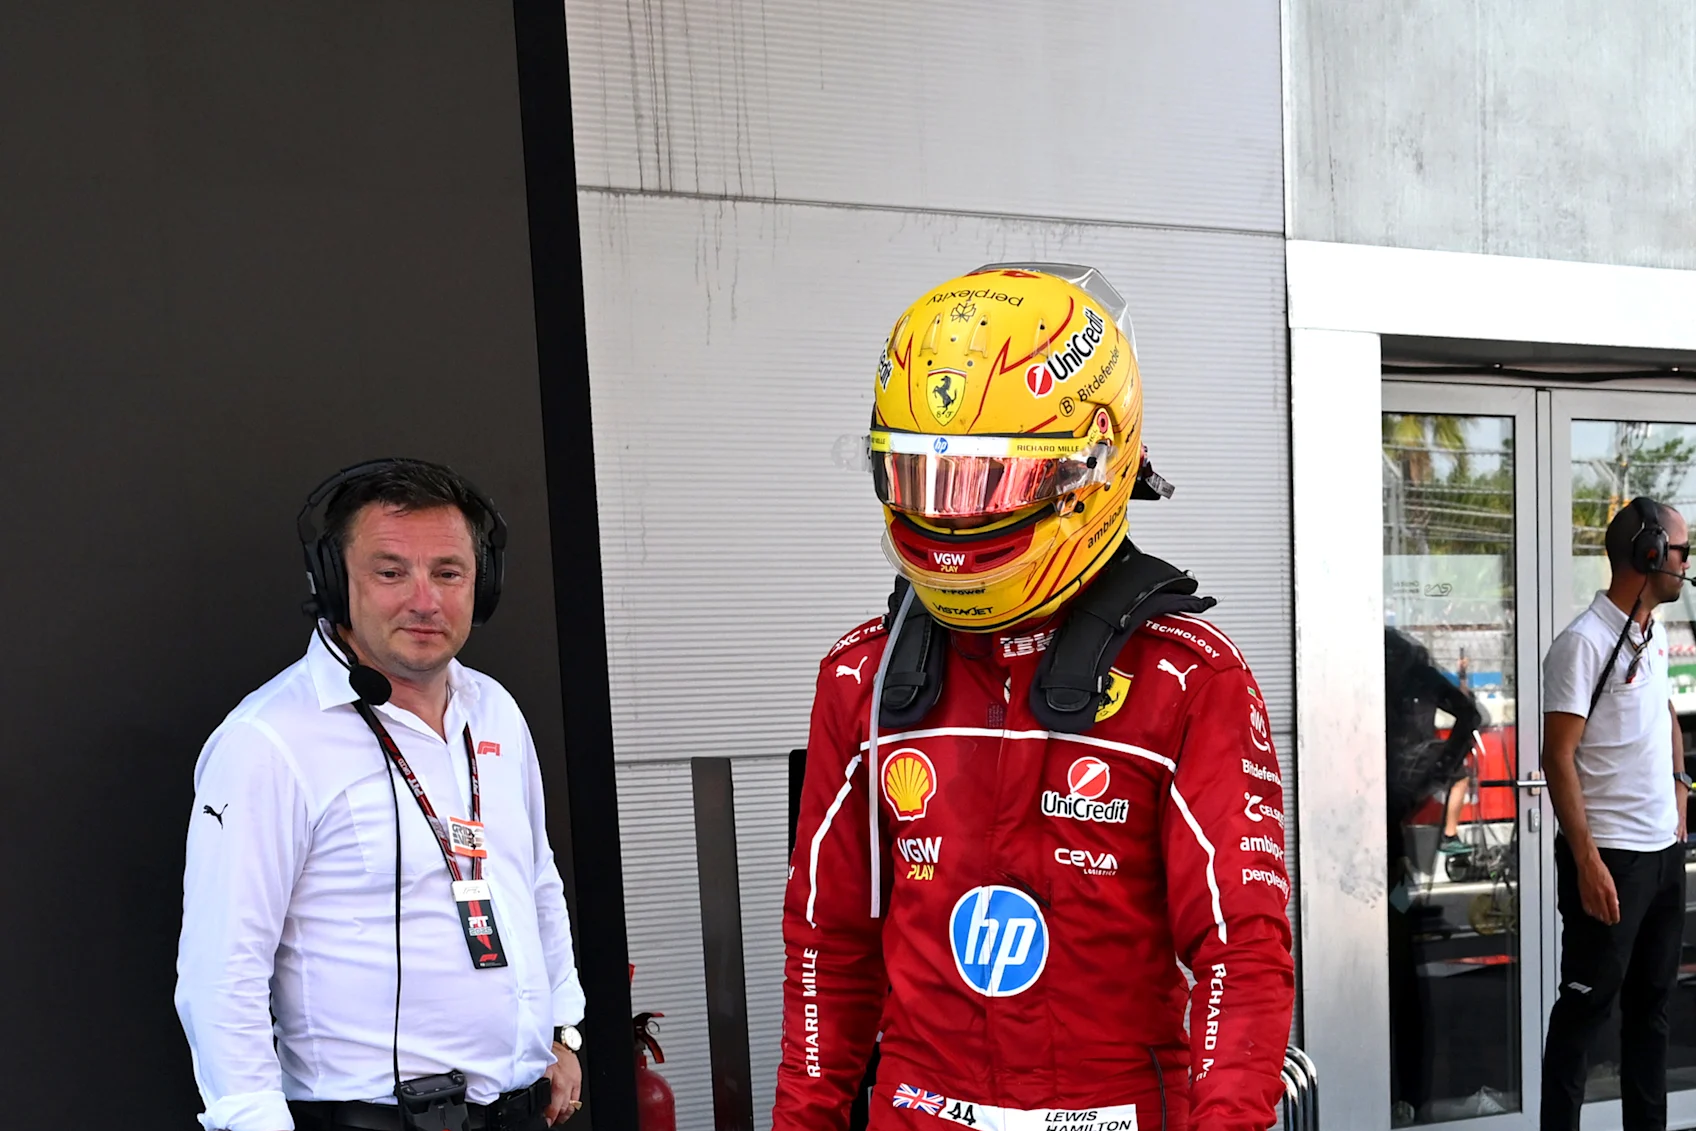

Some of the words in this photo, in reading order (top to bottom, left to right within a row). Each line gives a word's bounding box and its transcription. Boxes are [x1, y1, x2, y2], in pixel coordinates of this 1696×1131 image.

[926, 289, 1024, 307] perplexity
[1050, 309, 1104, 380] UniCredit
[1077, 344, 1120, 402] Bitdefender
[934, 437, 948, 453] hp
[1017, 444, 1055, 452] RICHARD
[933, 552, 965, 566] VGW
[940, 564, 958, 573] PLAY
[1145, 620, 1220, 658] TECHNOLOGY
[1042, 792, 1127, 821] UniCredit
[897, 836, 943, 863] VGW
[906, 864, 934, 881] PLAY
[962, 885, 1038, 997] hp
[802, 948, 818, 998] MILLE
[946, 1102, 977, 1126] 44
[1045, 1110, 1098, 1123] LEWIS
